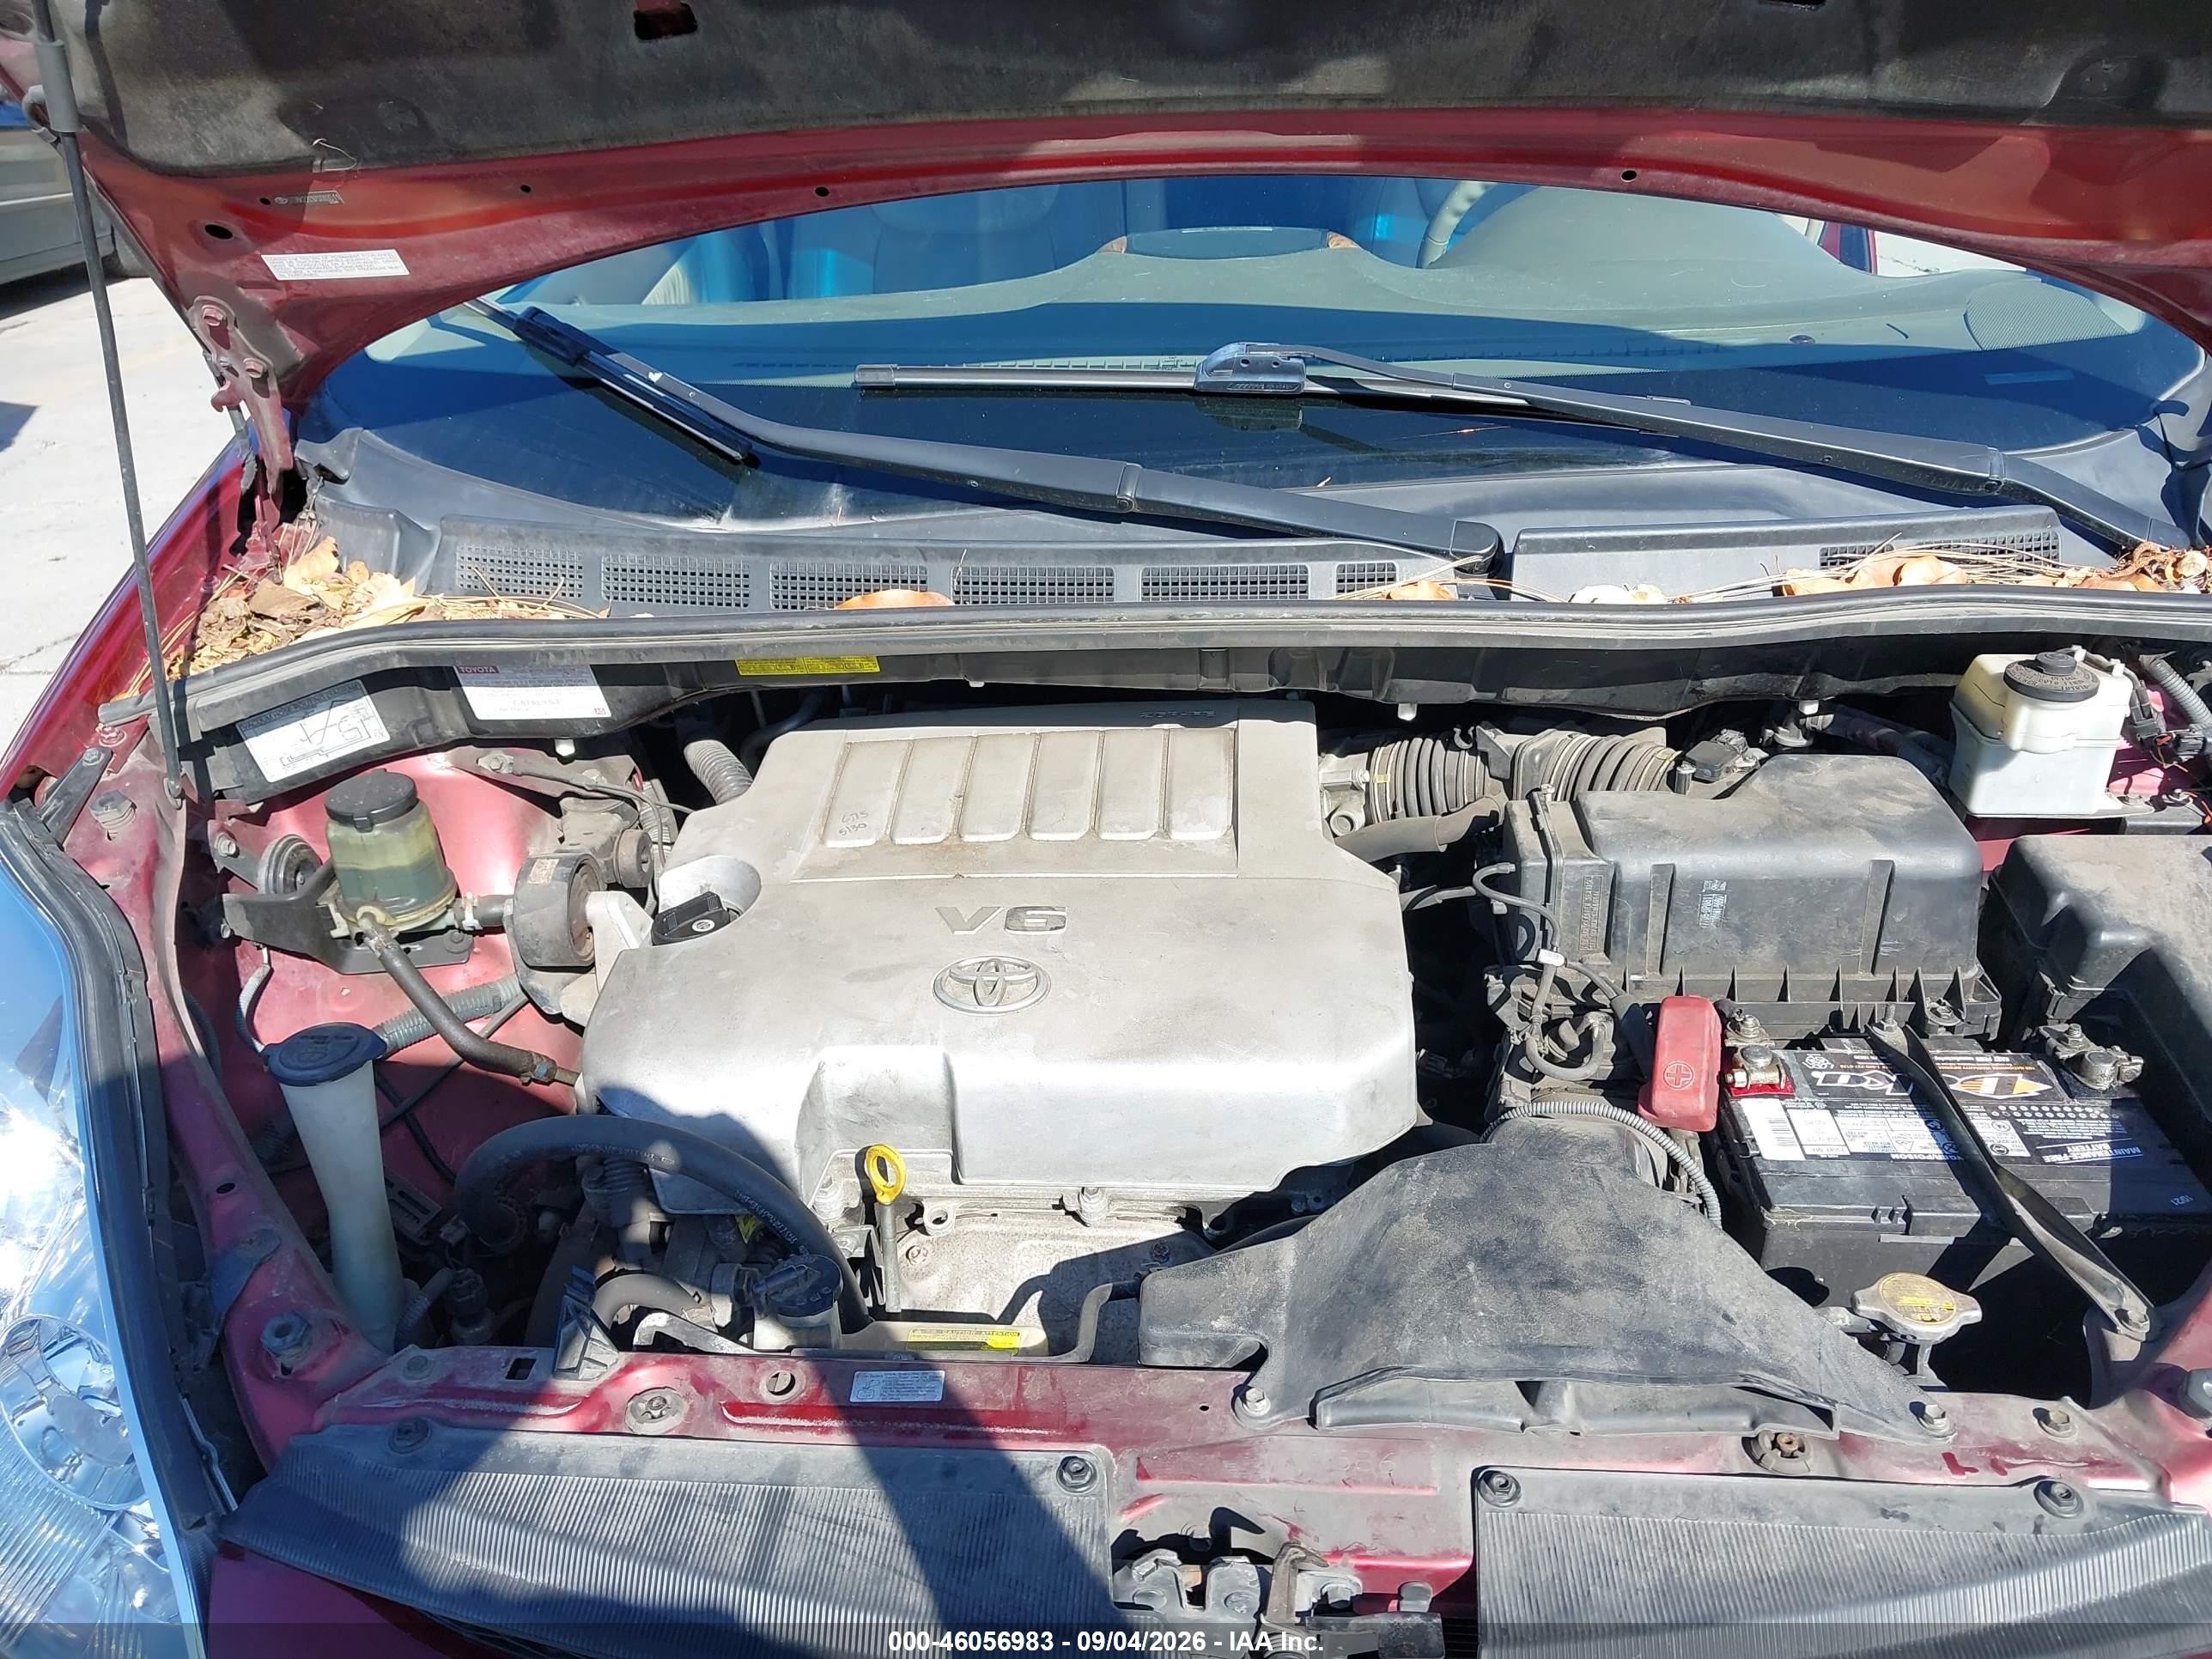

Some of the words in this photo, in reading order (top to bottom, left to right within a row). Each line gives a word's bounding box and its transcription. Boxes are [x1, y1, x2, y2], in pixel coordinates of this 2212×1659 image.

[935, 906, 1067, 934] V6
[2042, 1146, 2142, 1163] MAINTENANCE-FREE
[2066, 1143, 2112, 1152] BATTERY
